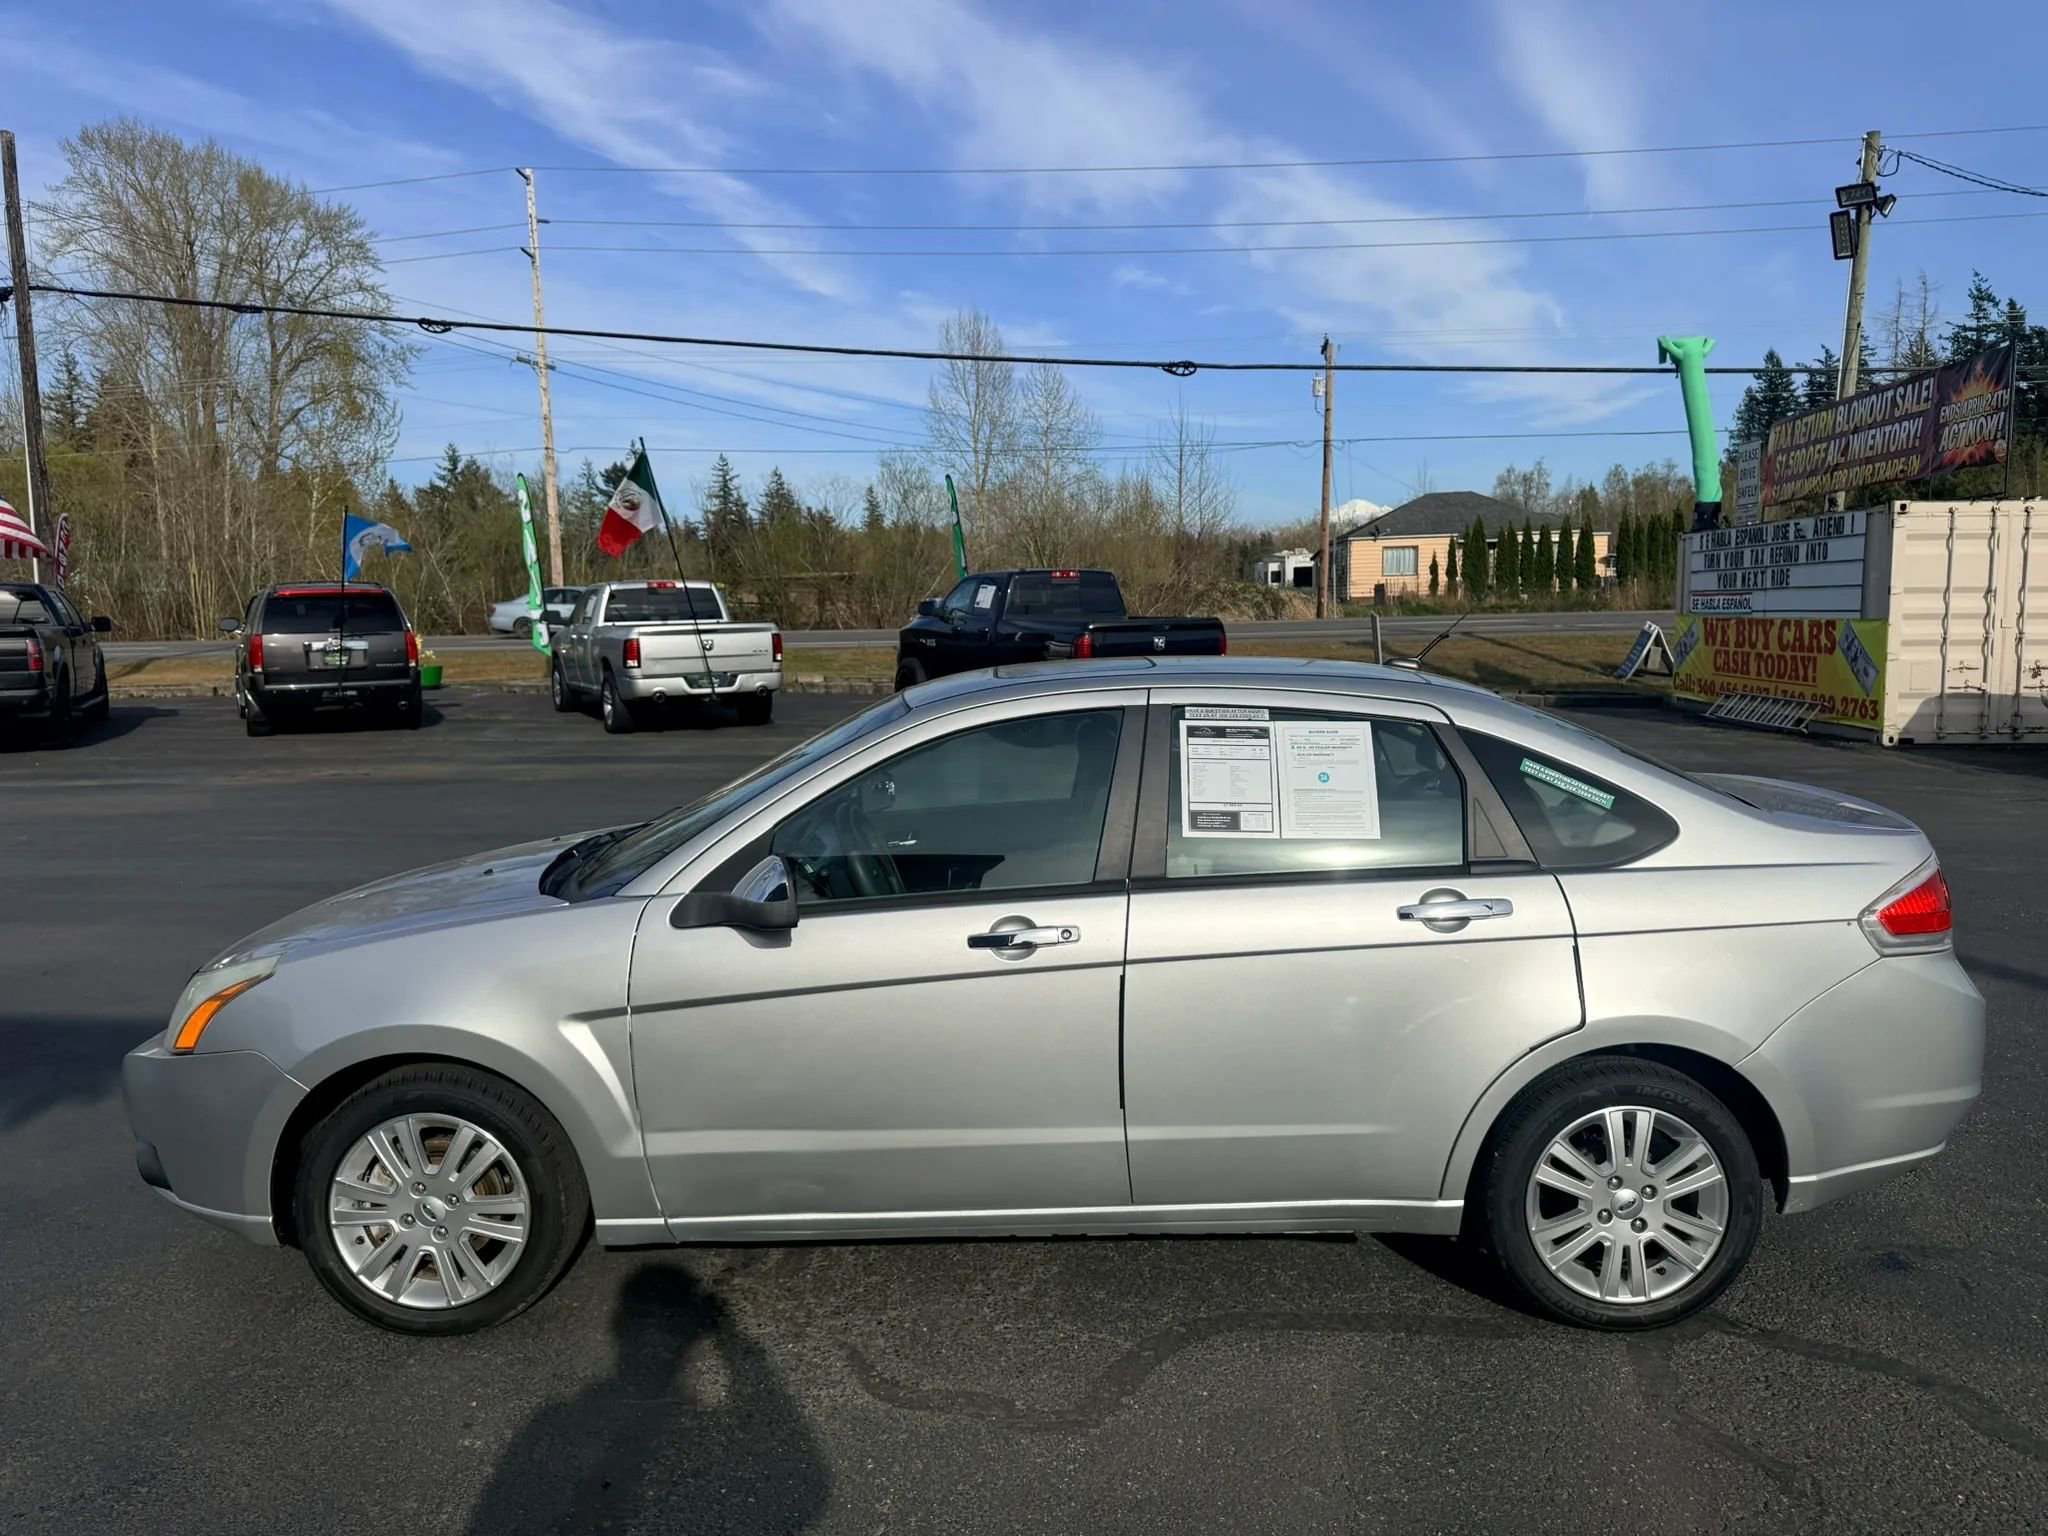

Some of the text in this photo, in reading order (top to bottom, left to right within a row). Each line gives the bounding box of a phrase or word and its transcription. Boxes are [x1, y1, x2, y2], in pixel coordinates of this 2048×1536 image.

[1775, 377, 1934, 450] TAX RETURN BLOWOUT SALE!
[1846, 417, 1924, 462] INVENTORY!
[1938, 411, 2005, 452] ACT NOW!
[1771, 523, 1790, 542] JOSE
[1704, 542, 1828, 569] TURN YOUR TAX REFUND INTO
[1717, 568, 1790, 589] YOUR NEXT RIDE
[1703, 617, 1837, 655] WE BUY CARS
[1673, 672, 1695, 692] Call:
[1713, 649, 1818, 684] CASH TODAY!
